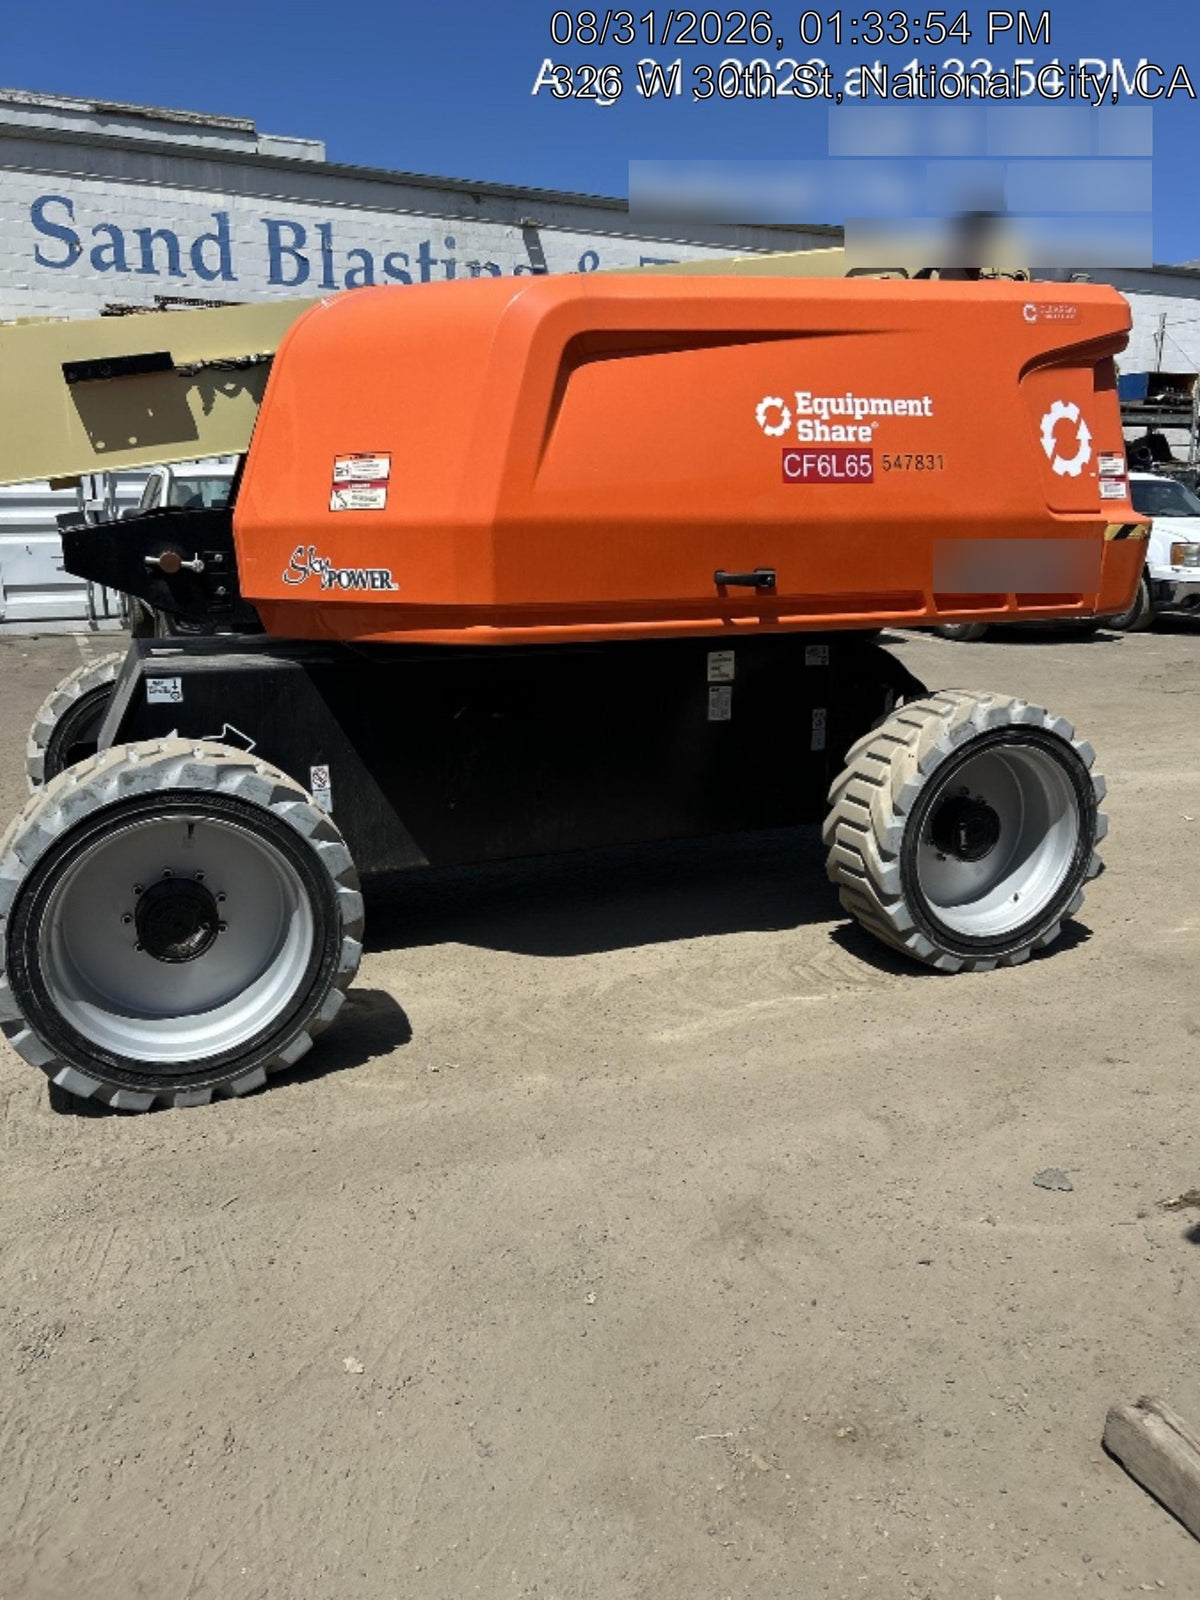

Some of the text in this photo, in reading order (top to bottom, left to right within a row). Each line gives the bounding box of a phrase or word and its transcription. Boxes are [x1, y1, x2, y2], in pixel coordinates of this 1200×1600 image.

[30, 194, 549, 290] Sand Blasti
[795, 391, 933, 420] Equipment
[784, 453, 944, 477] CF6L65 547831
